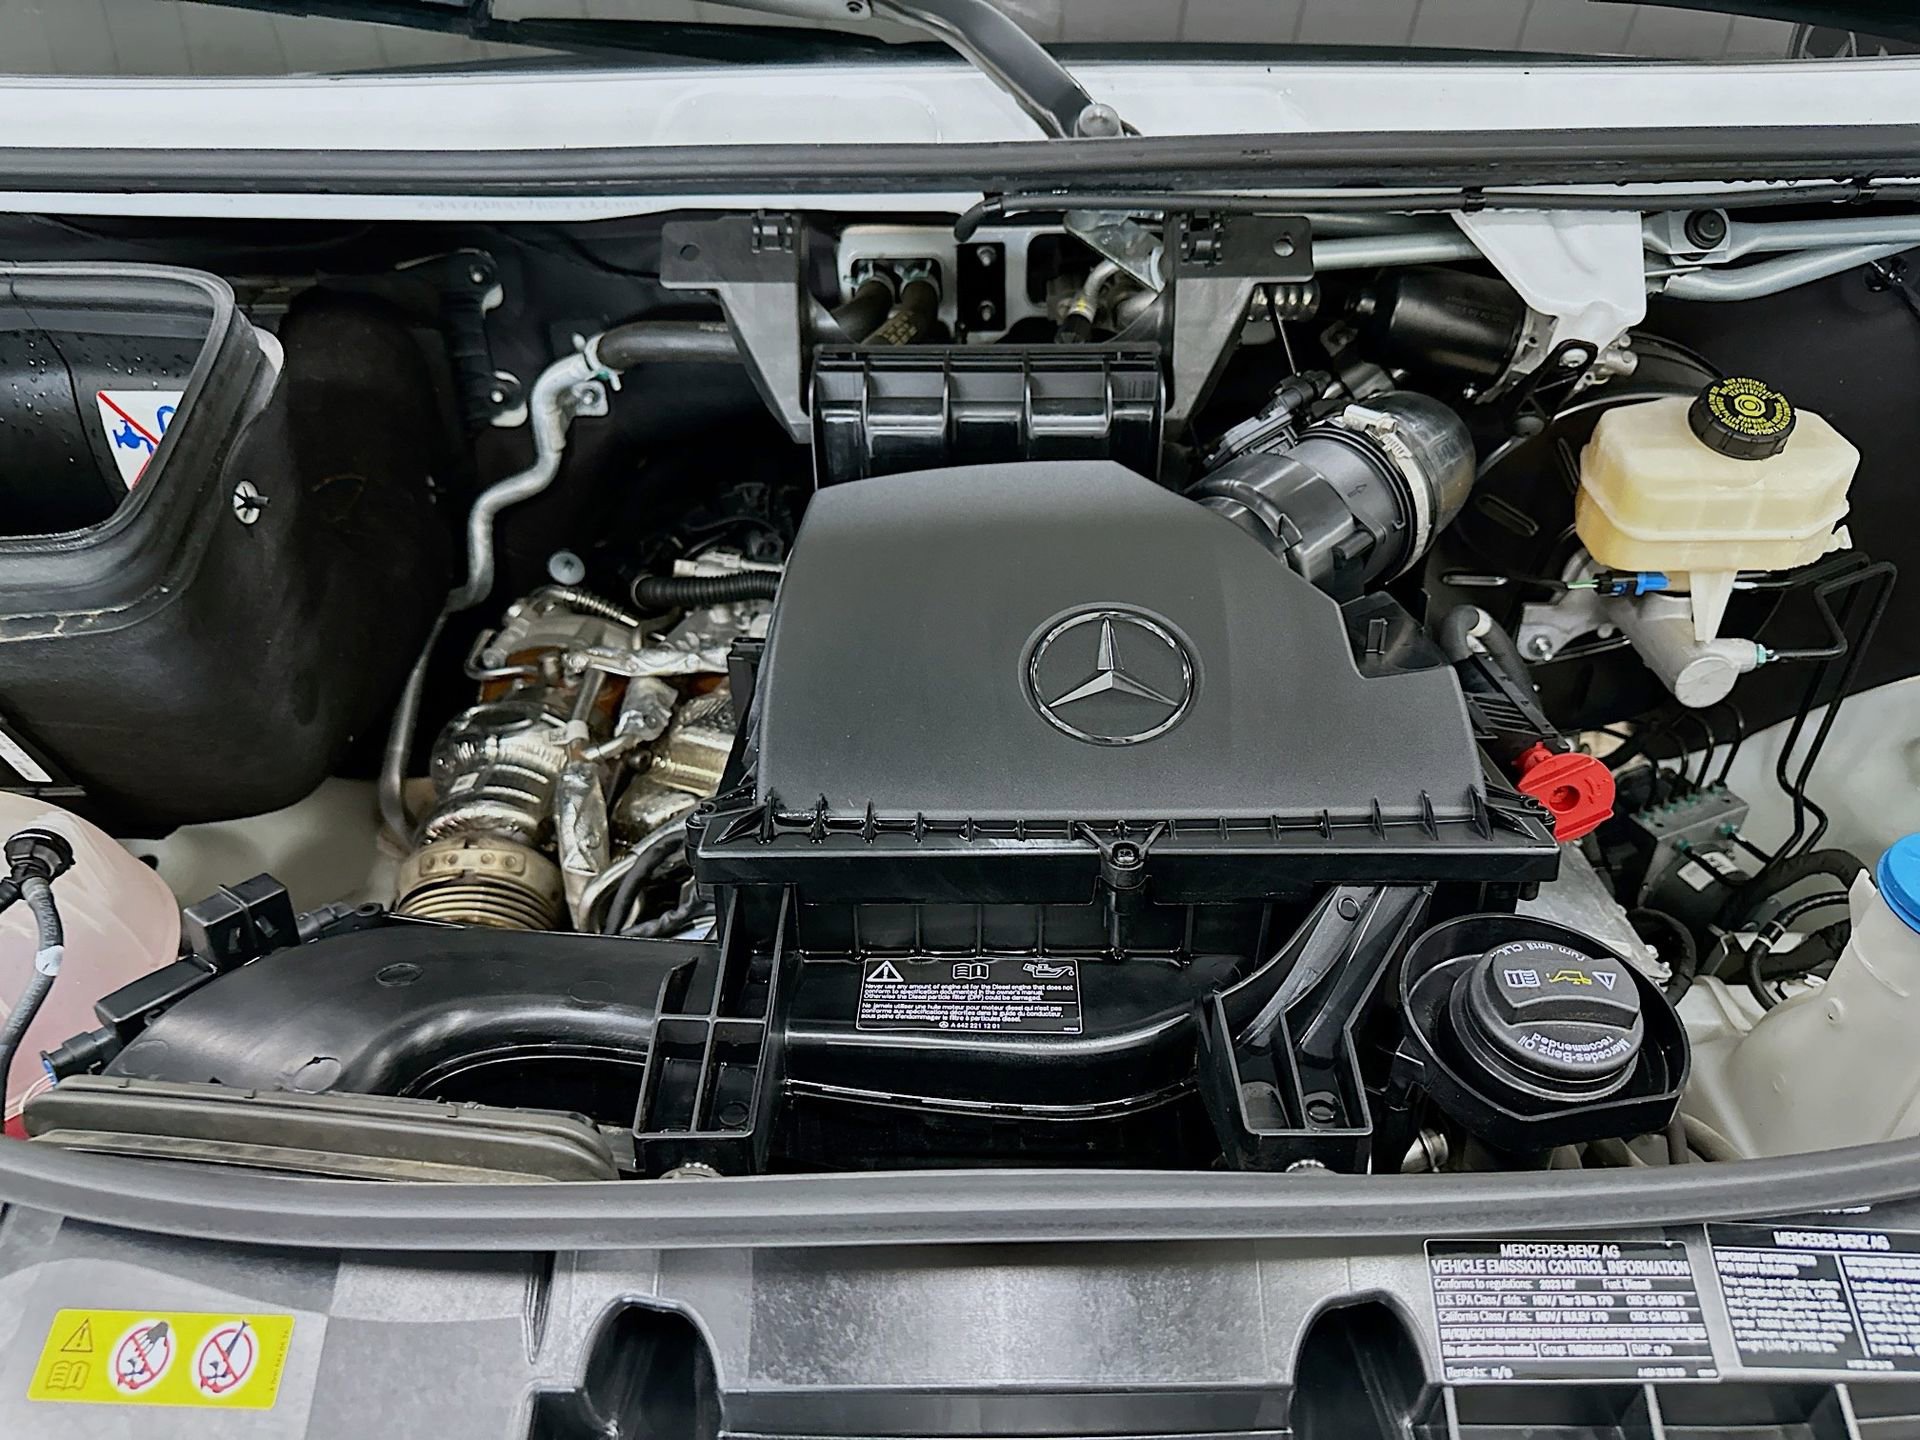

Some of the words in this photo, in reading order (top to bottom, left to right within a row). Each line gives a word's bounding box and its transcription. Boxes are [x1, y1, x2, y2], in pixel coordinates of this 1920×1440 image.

[1526, 942, 1554, 951] until
[1559, 947, 1586, 962] Turn
[873, 1002, 893, 1010] jamais
[1518, 1035, 1536, 1050] Oil
[1532, 1032, 1614, 1052] recommended
[1538, 1038, 1631, 1064] Mercedes-Benz
[1500, 1244, 1601, 1258] MERCEDES-BENZ
[1602, 1245, 1620, 1259] AG
[1431, 1260, 1486, 1274] VEHICLE
[1486, 1260, 1548, 1274] EMISSION
[1548, 1260, 1607, 1275] CONTROL
[1607, 1260, 1690, 1275] INFORMATION
[1435, 1279, 1474, 1290] Conforms
[1476, 1279, 1485, 1289] to
[1486, 1279, 1533, 1290] regulations:
[1623, 1279, 1652, 1290] Diesel
[1437, 1295, 1454, 1306] U.S.
[1456, 1295, 1473, 1305] EPA
[1439, 1311, 1479, 1322] California
[1446, 1366, 1488, 1378] Remarks:
